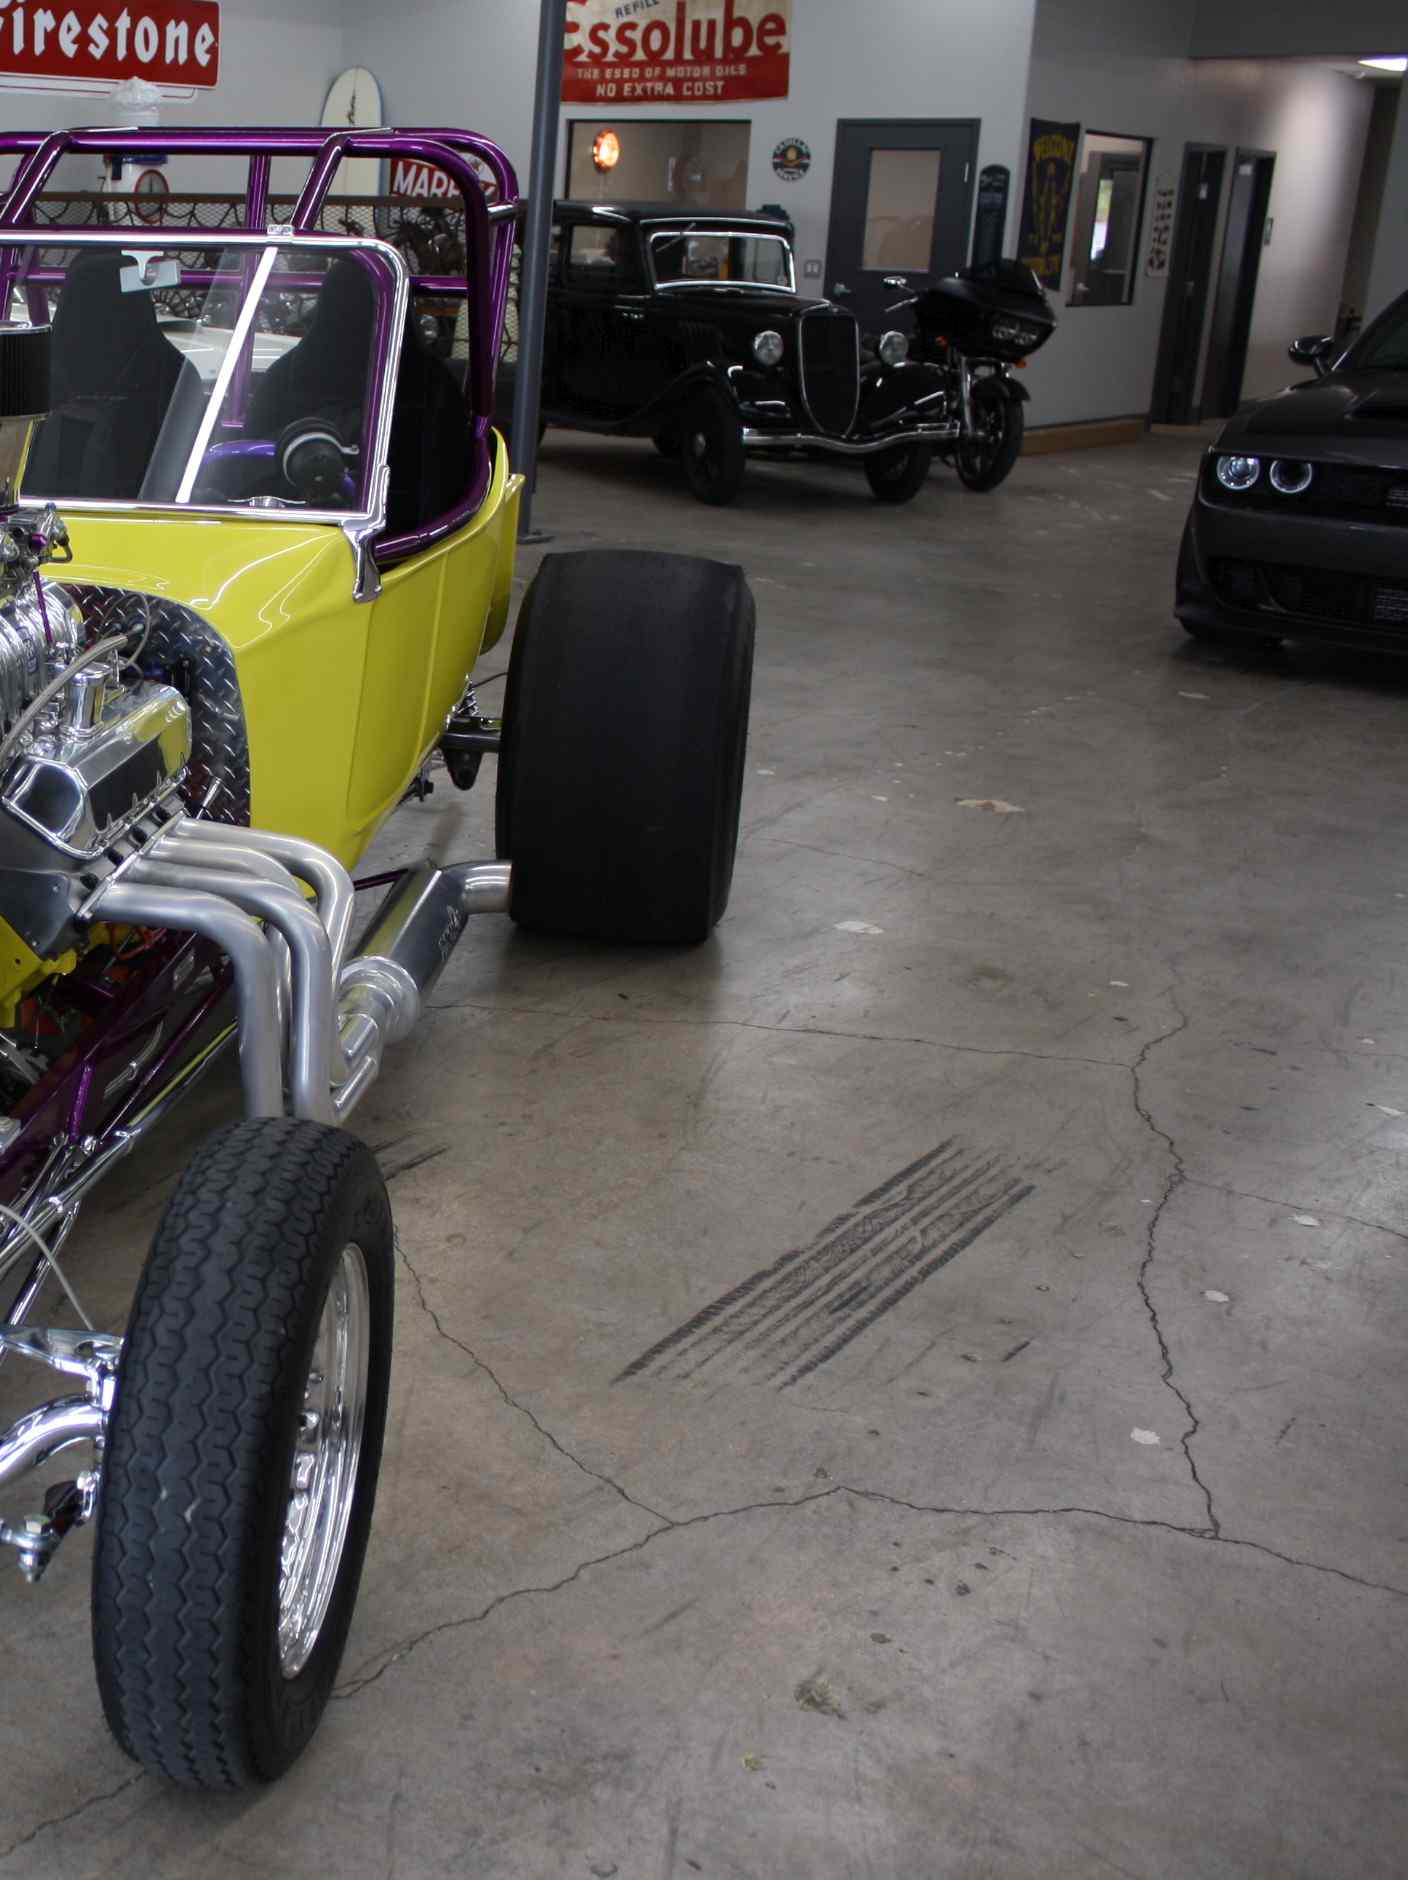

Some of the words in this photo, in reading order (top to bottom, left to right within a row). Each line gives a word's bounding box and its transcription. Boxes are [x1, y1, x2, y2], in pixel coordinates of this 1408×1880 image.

[577, 68, 600, 79] THE
[645, 67, 662, 78] OF
[666, 66, 711, 78] MOTOR
[716, 64, 747, 76] OILS
[596, 83, 616, 97] NO
[623, 82, 674, 96] EXTRA
[683, 81, 725, 95] COST
